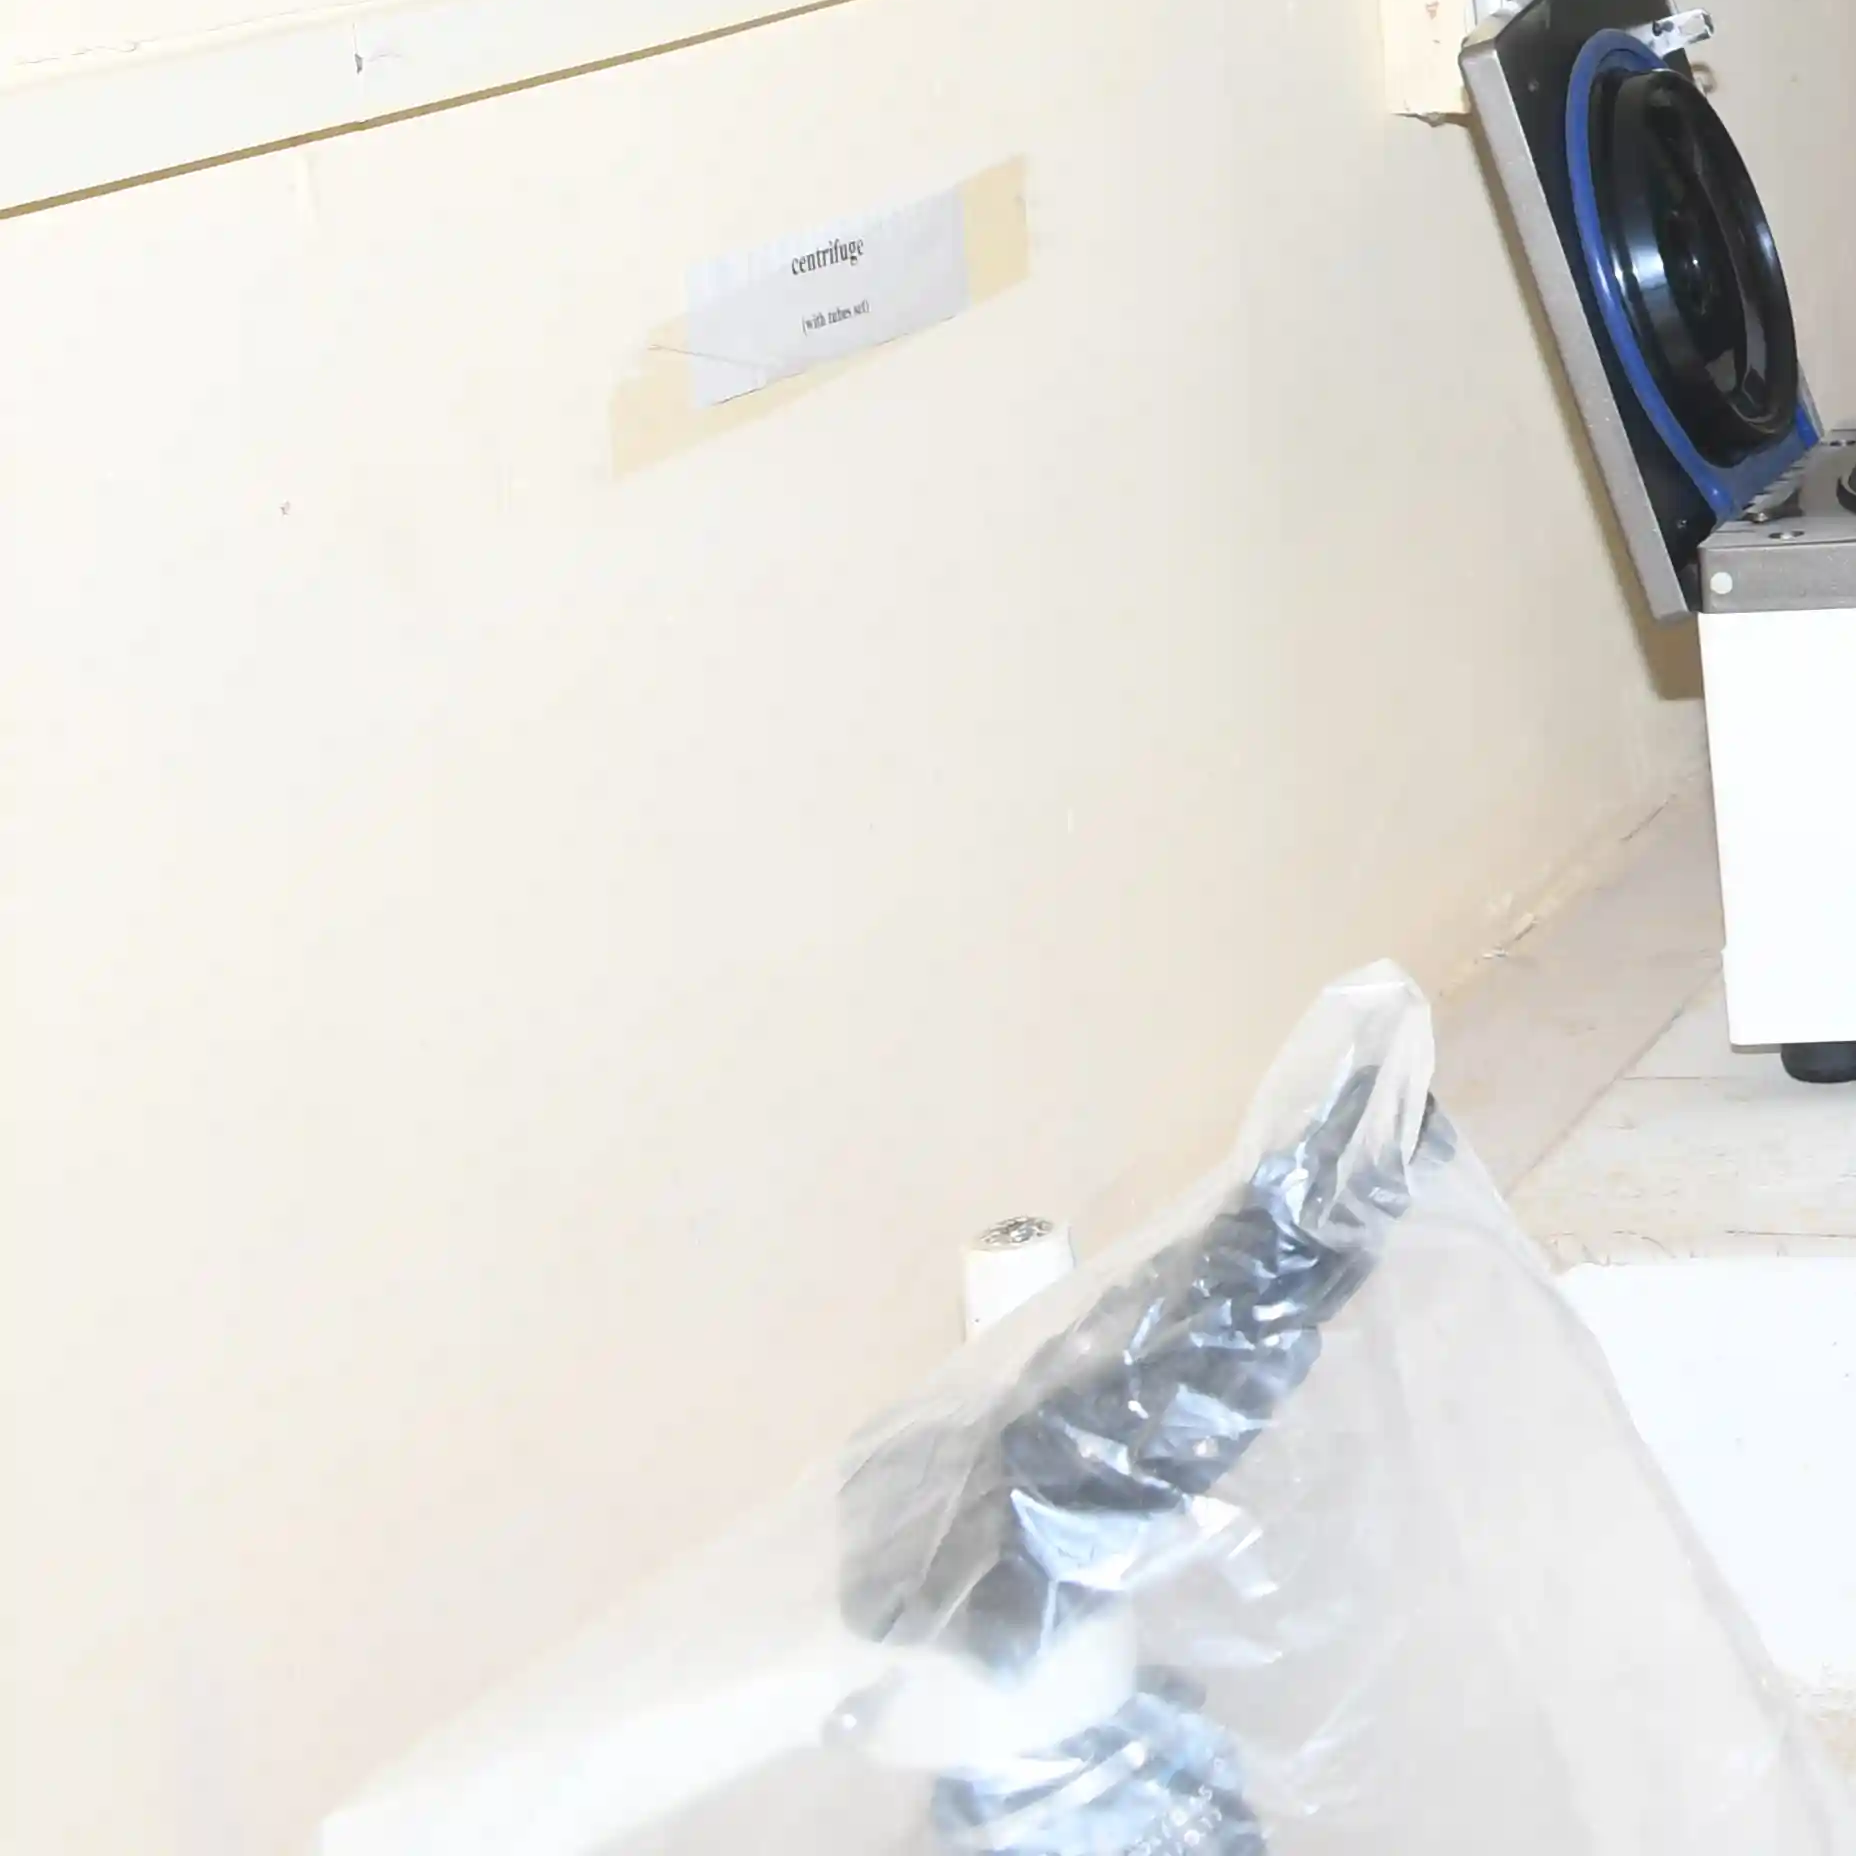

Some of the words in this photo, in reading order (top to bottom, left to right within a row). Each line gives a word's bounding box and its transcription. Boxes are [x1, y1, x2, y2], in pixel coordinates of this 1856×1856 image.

[791, 238, 864, 275] centrifuge
[801, 311, 826, 337] (with
[827, 306, 852, 325] tubes
